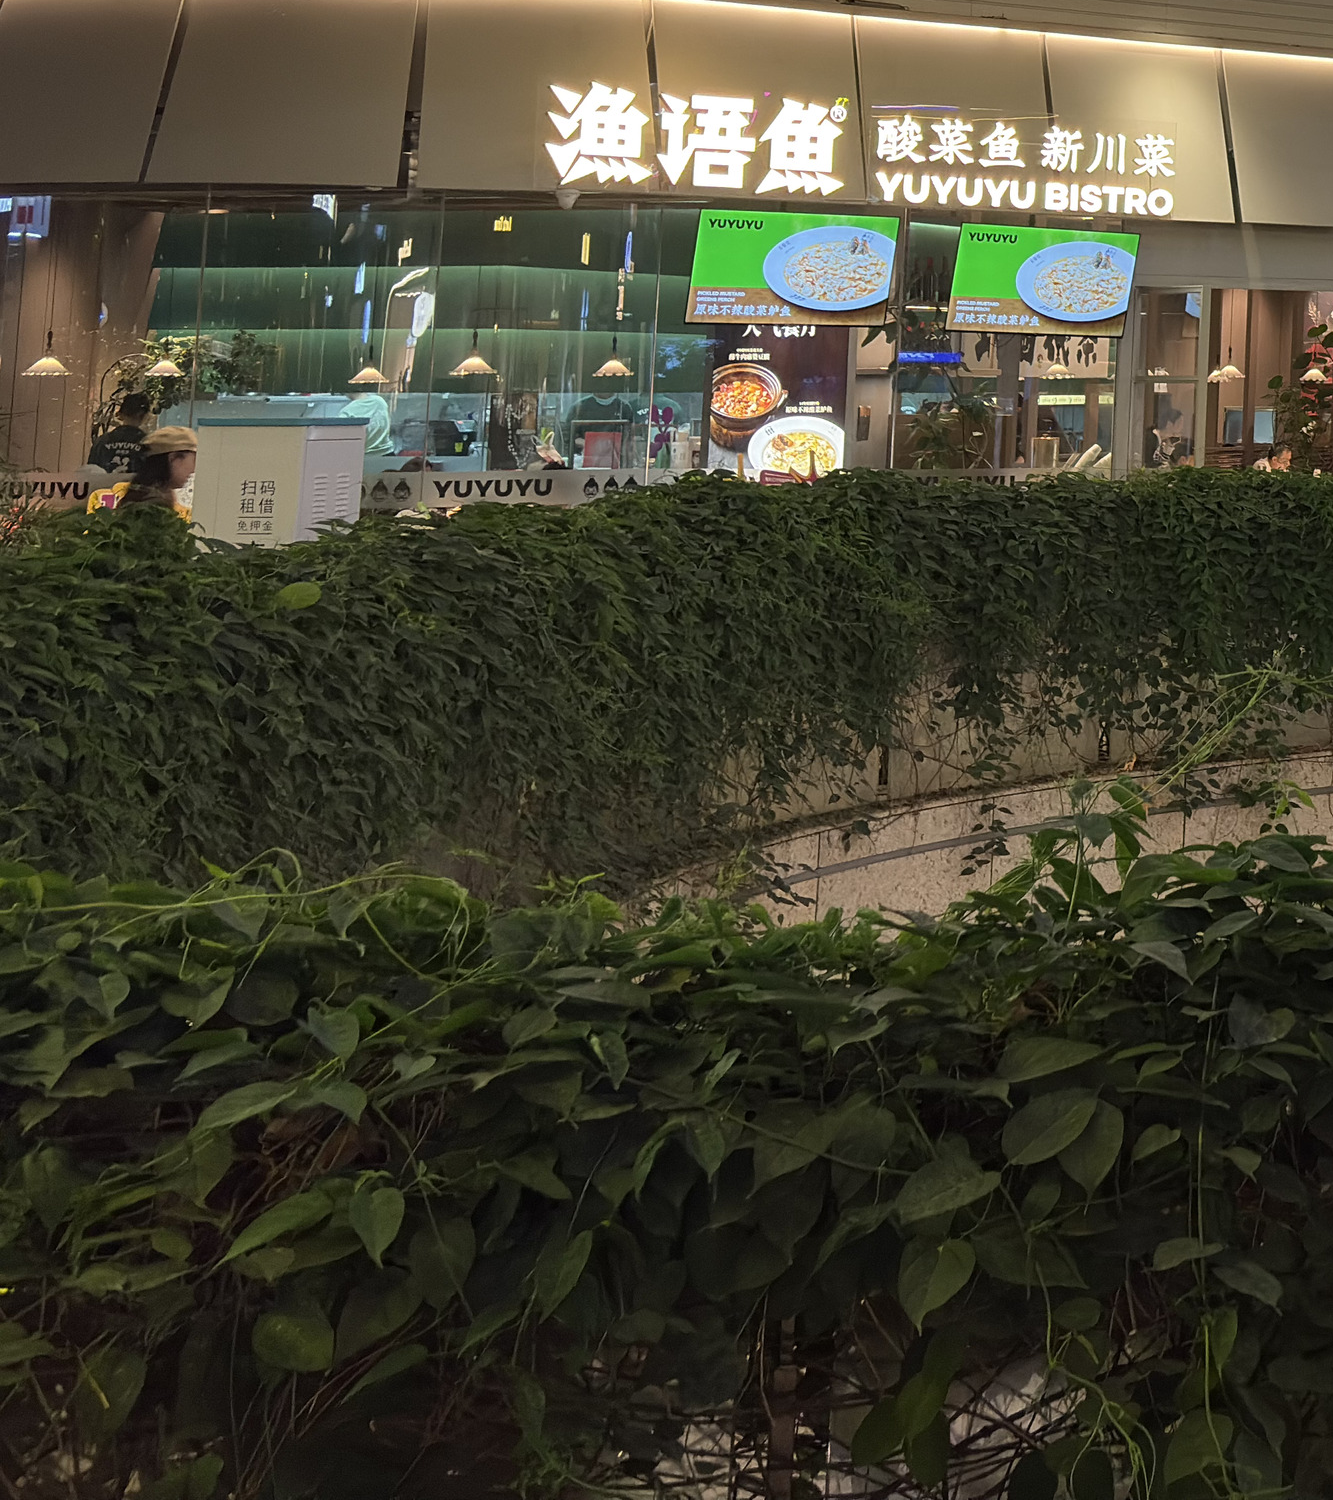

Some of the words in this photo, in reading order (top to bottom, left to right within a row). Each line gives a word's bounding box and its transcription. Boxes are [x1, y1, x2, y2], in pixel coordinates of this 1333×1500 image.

[876, 115, 1026, 168] 酸菜鱼
[1040, 125, 1176, 178] 新川菜
[875, 171, 1036, 210] YUYUYU
[1044, 182, 1174, 217] BISTRO
[709, 218, 764, 230] YUYUYU
[969, 232, 1018, 244] YUYUYU
[694, 303, 792, 317] 原味不辣酸菜鲈鱼
[104, 442, 141, 452] YUYUYU
[241, 480, 276, 496] 扫码
[433, 478, 553, 498] YUYUYU
[240, 498, 275, 514] 租借
[237, 520, 273, 532] 免押金
